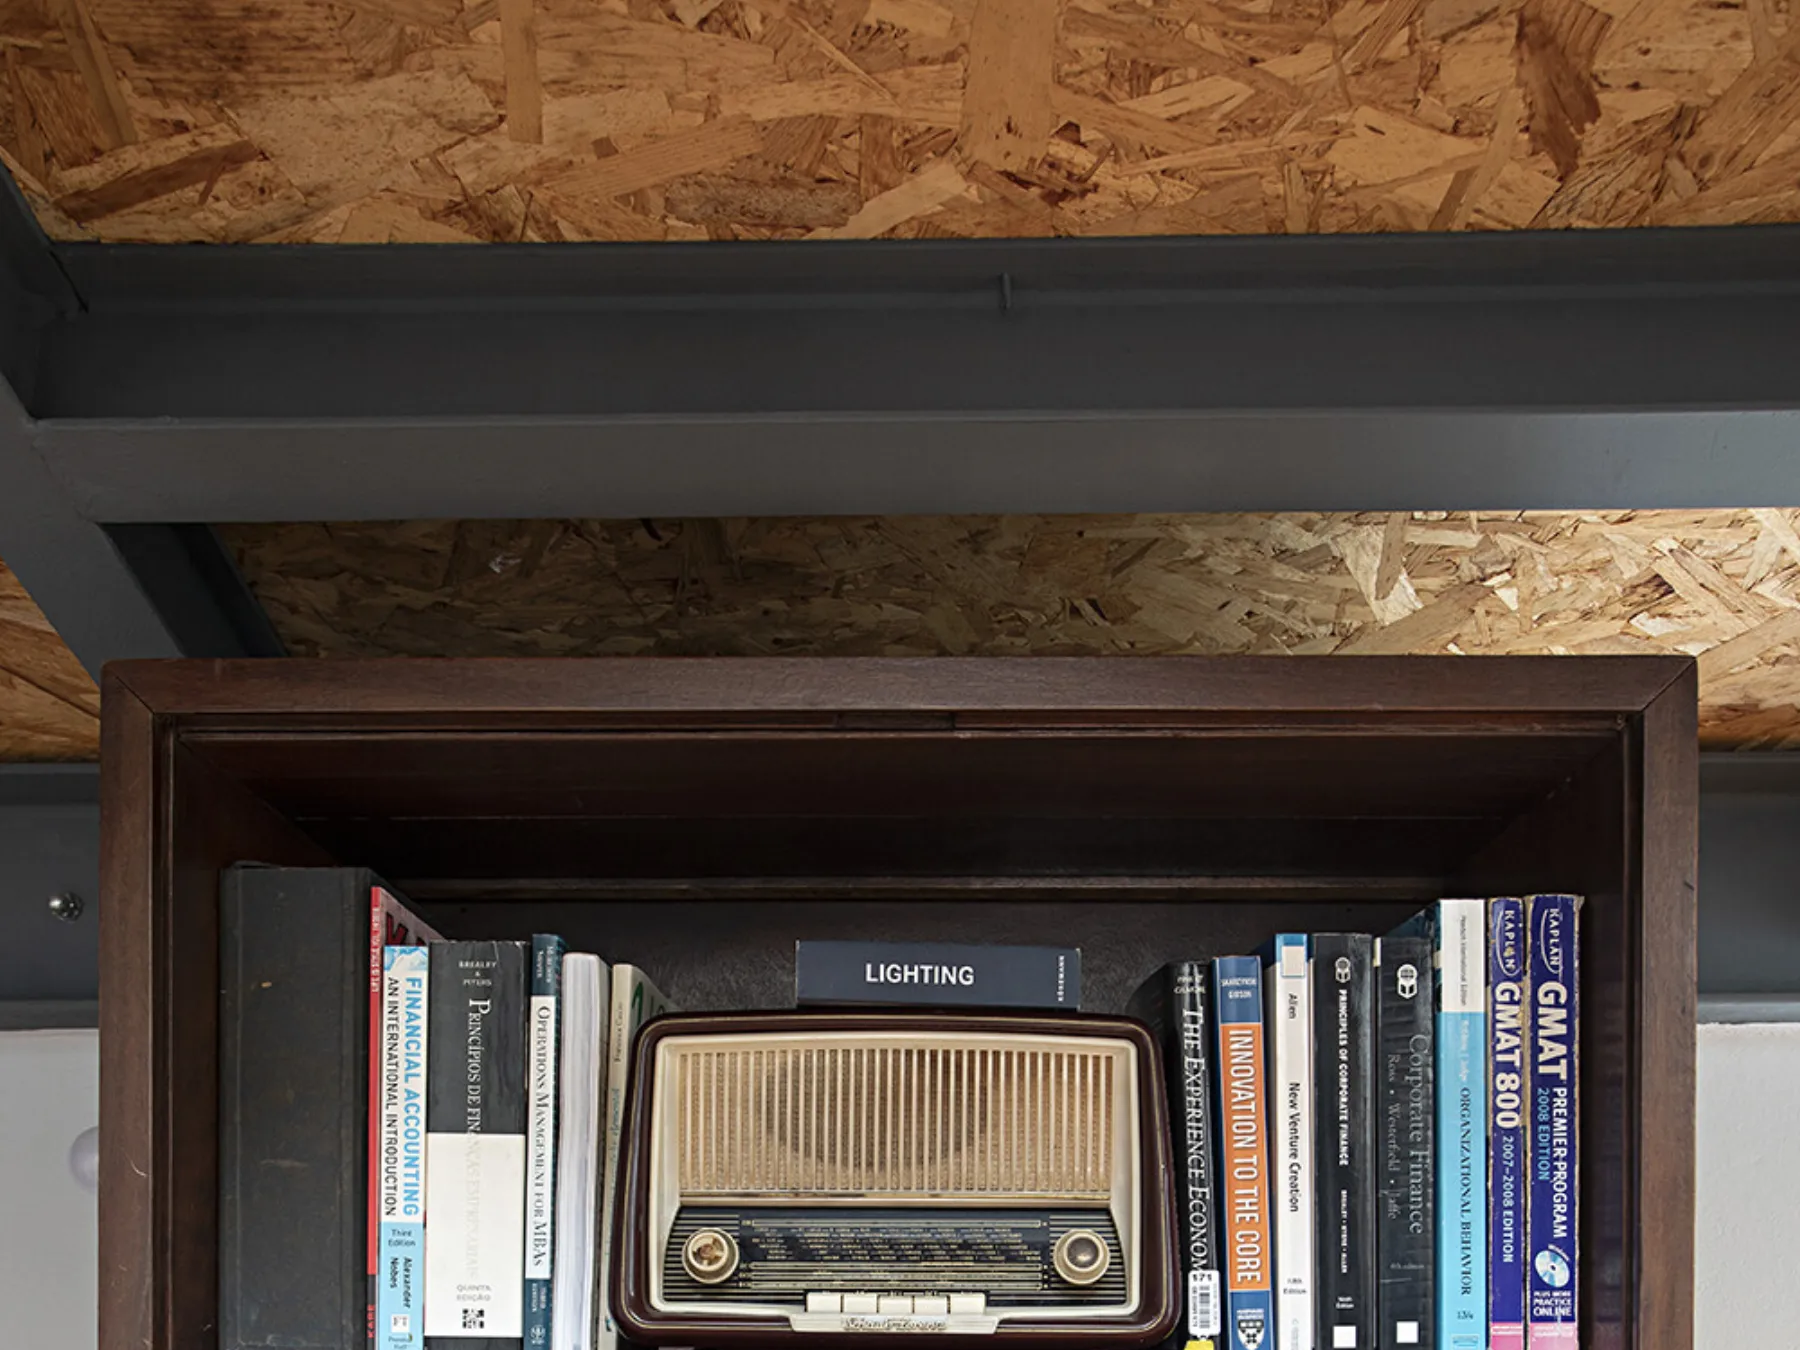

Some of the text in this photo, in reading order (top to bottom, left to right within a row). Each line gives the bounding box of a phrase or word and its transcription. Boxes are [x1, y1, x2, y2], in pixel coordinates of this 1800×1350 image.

[1549, 908, 1561, 966] KAPLAN
[865, 963, 975, 986] LIGHTING
[1288, 993, 1299, 1019] Allen
[536, 1006, 551, 1088] OPERATIONS
[1182, 1006, 1204, 1050] THE
[1495, 982, 1521, 1129] GMAT 800
[1538, 981, 1567, 1080] GMAT
[384, 977, 399, 1216] AN INTERNATIONAL INTRODUCTION
[403, 977, 422, 1217] FINANCIAL ACCOUNTING
[467, 1084, 481, 1105] DE
[1338, 989, 1349, 1166] PRINCIPLES OF CORPORATE FINANCE
[1388, 1054, 1400, 1082] Ross
[534, 1091, 550, 1187] MANAGEMENT
[1184, 1056, 1206, 1179] EXPERIENCE
[1288, 1082, 1301, 1212] New Venture Creation
[1388, 1102, 1401, 1171] Westerfield
[1404, 1034, 1430, 1234] Corporate Finance
[1537, 1088, 1550, 1181] 2008 EDITION
[1553, 1087, 1568, 1158] PREMIER
[1229, 1029, 1261, 1283] INNOVATION TO THE CORE
[1460, 1087, 1472, 1296] ORGANIZATIONAL BEHAVIOR
[392, 1229, 412, 1237] Third
[533, 1193, 544, 1218] FOR
[1188, 1186, 1211, 1271] ECONOM
[1553, 1161, 1568, 1238] PROGRAM
[388, 1239, 415, 1247] Edition
[1502, 1211, 1514, 1263] EDITION
[403, 1256, 413, 1309] Alexander
[457, 1284, 492, 1292] QUINTA
[1533, 1298, 1572, 1306] PRACTICE
[1533, 1307, 1572, 1317] ONLINE
